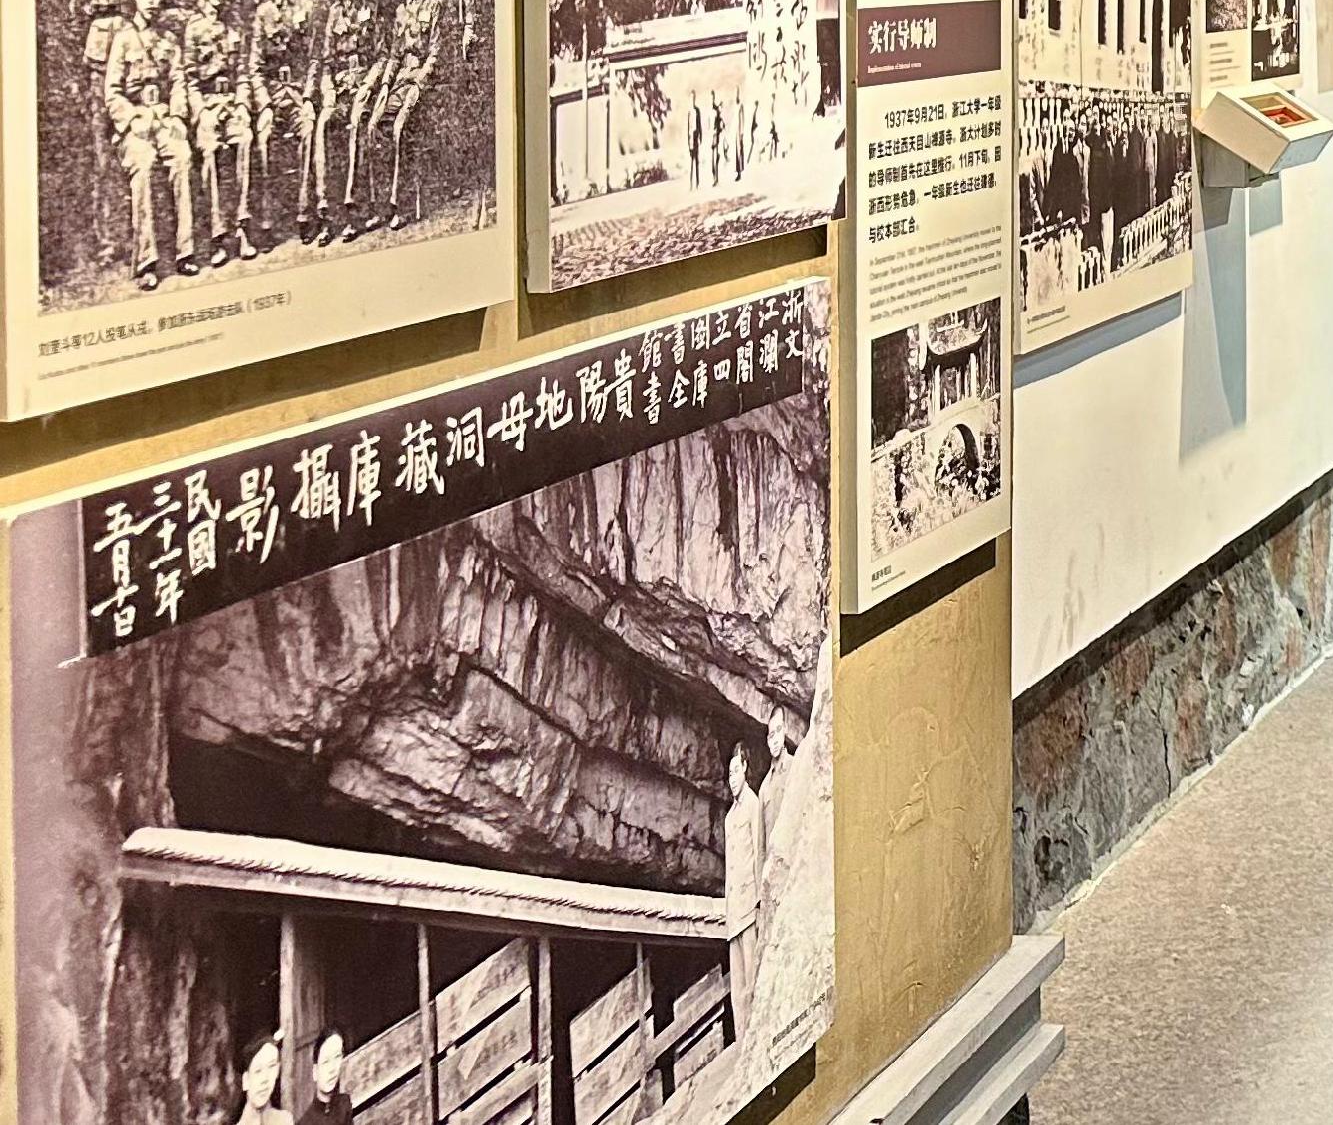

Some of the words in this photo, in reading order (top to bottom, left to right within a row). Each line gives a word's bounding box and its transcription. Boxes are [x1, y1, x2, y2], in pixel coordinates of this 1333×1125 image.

[867, 17, 937, 55] 实行导师制
